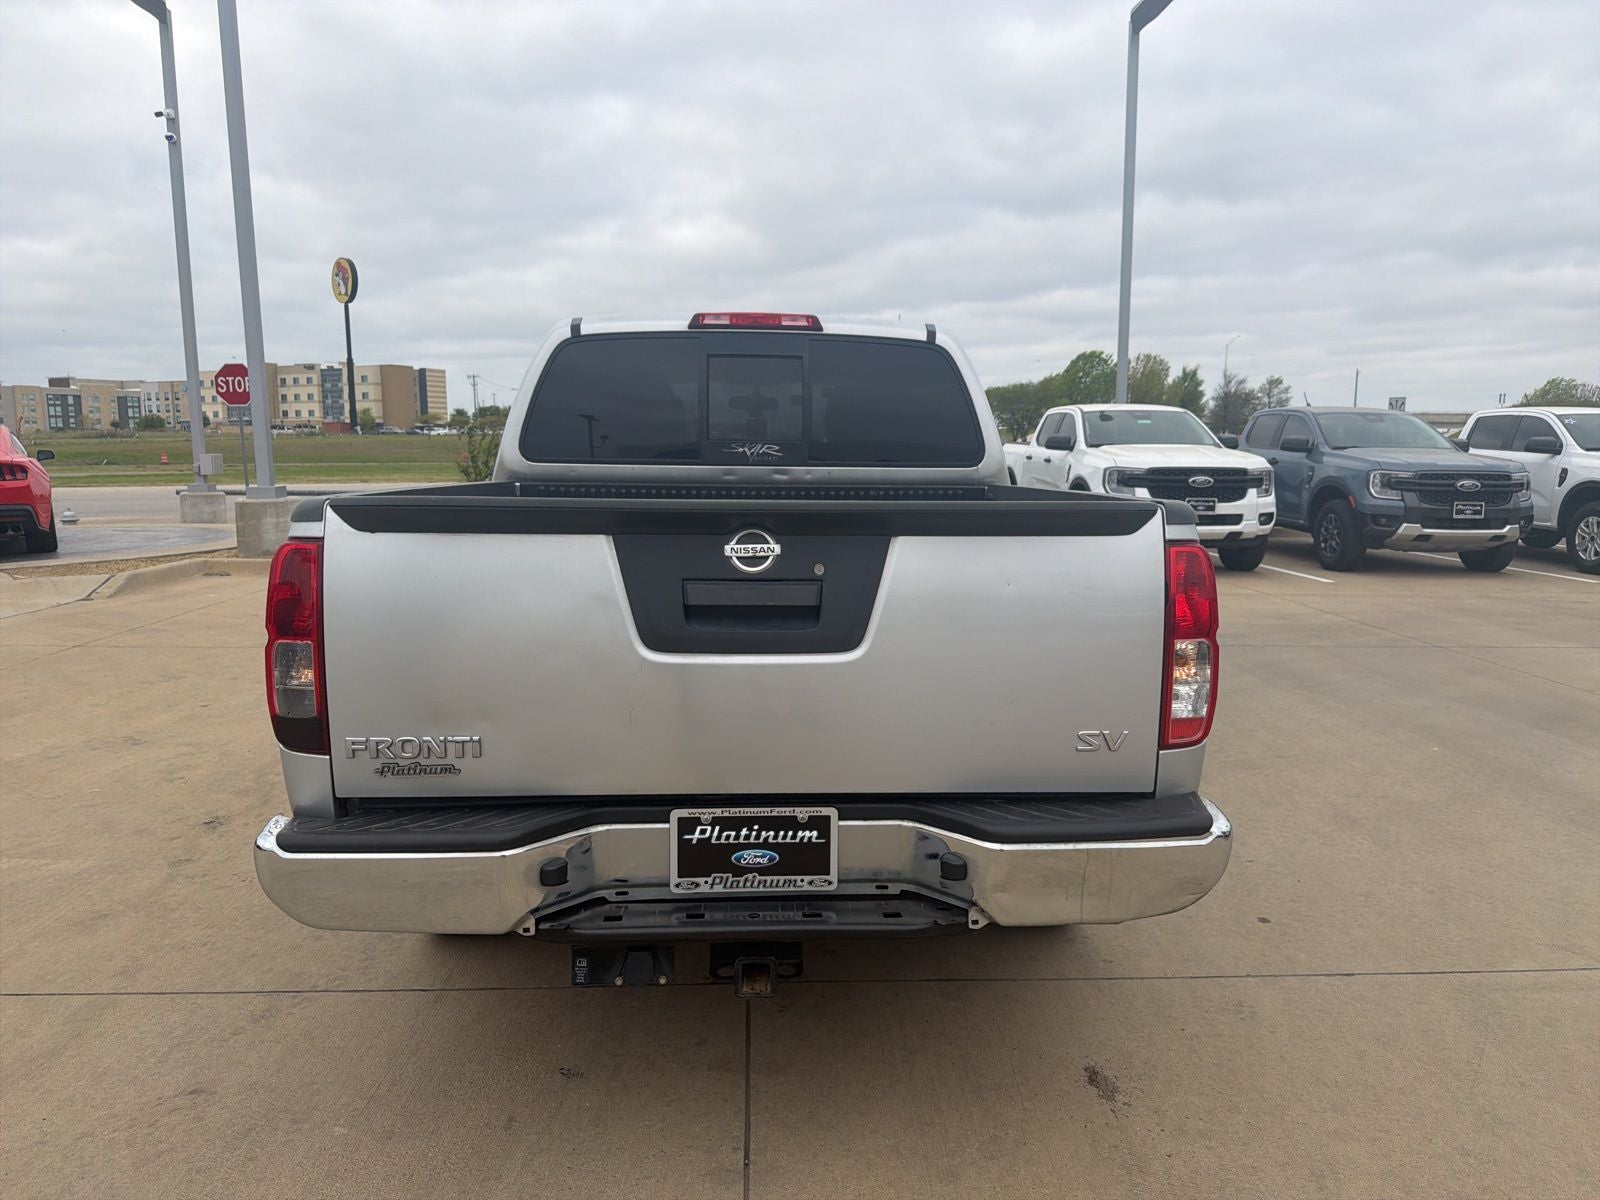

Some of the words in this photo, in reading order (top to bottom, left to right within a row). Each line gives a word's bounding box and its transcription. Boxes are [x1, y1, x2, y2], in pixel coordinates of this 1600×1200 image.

[730, 546, 775, 555] NISSAN
[345, 735, 482, 759] FRONTI
[1075, 730, 1129, 752] SV
[374, 762, 461, 777] Platinum
[687, 808, 822, 816] www.PlatinumFord.com
[682, 825, 826, 844] Platinum
[740, 852, 770, 864] Ford
[709, 874, 804, 889] Platinum
